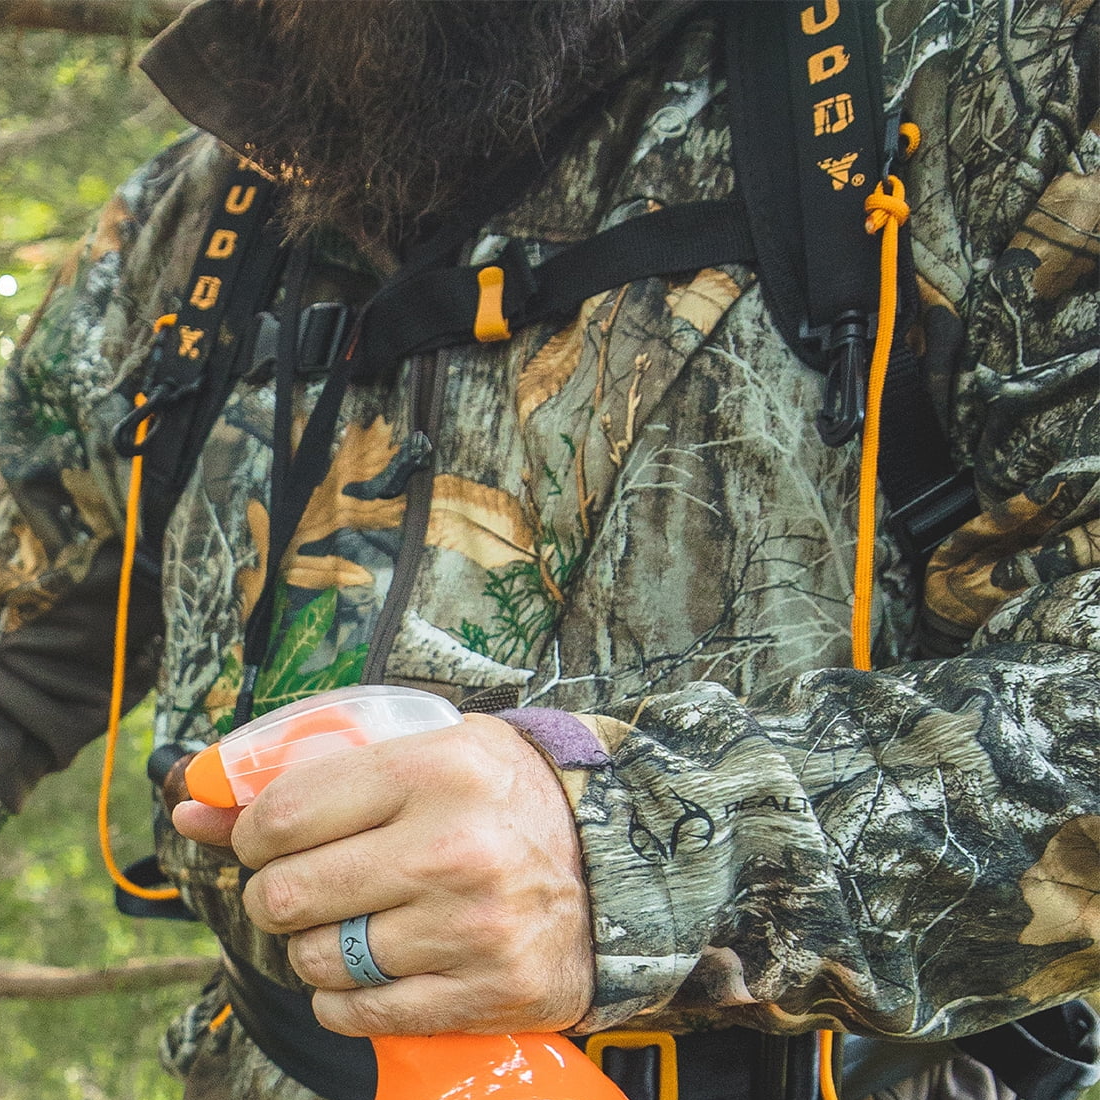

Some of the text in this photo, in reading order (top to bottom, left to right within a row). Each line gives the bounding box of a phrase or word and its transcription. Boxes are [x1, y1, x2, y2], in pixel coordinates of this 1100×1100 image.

[801, 0, 859, 191] UDDY
[178, 182, 258, 358] UDDY
[724, 795, 809, 819] REALT
